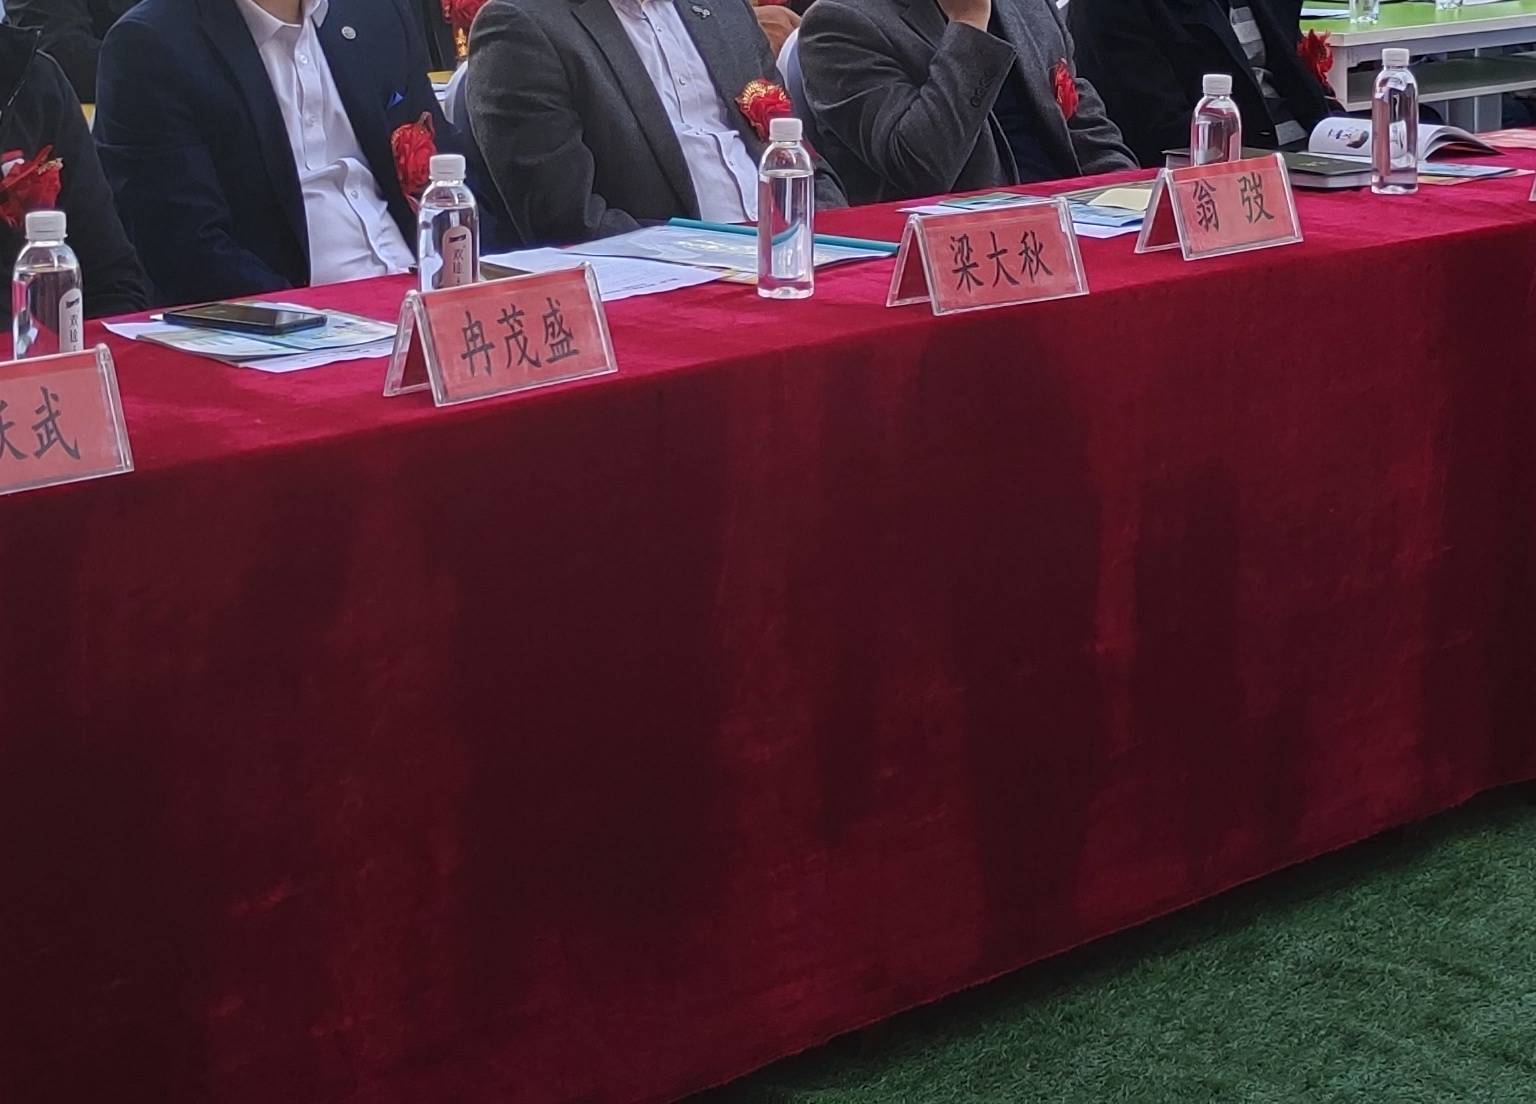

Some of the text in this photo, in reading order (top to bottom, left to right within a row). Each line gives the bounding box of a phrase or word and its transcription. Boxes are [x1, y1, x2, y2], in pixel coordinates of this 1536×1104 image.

[949, 229, 1055, 294] 梁大秋
[459, 297, 581, 379] 冉茂盛
